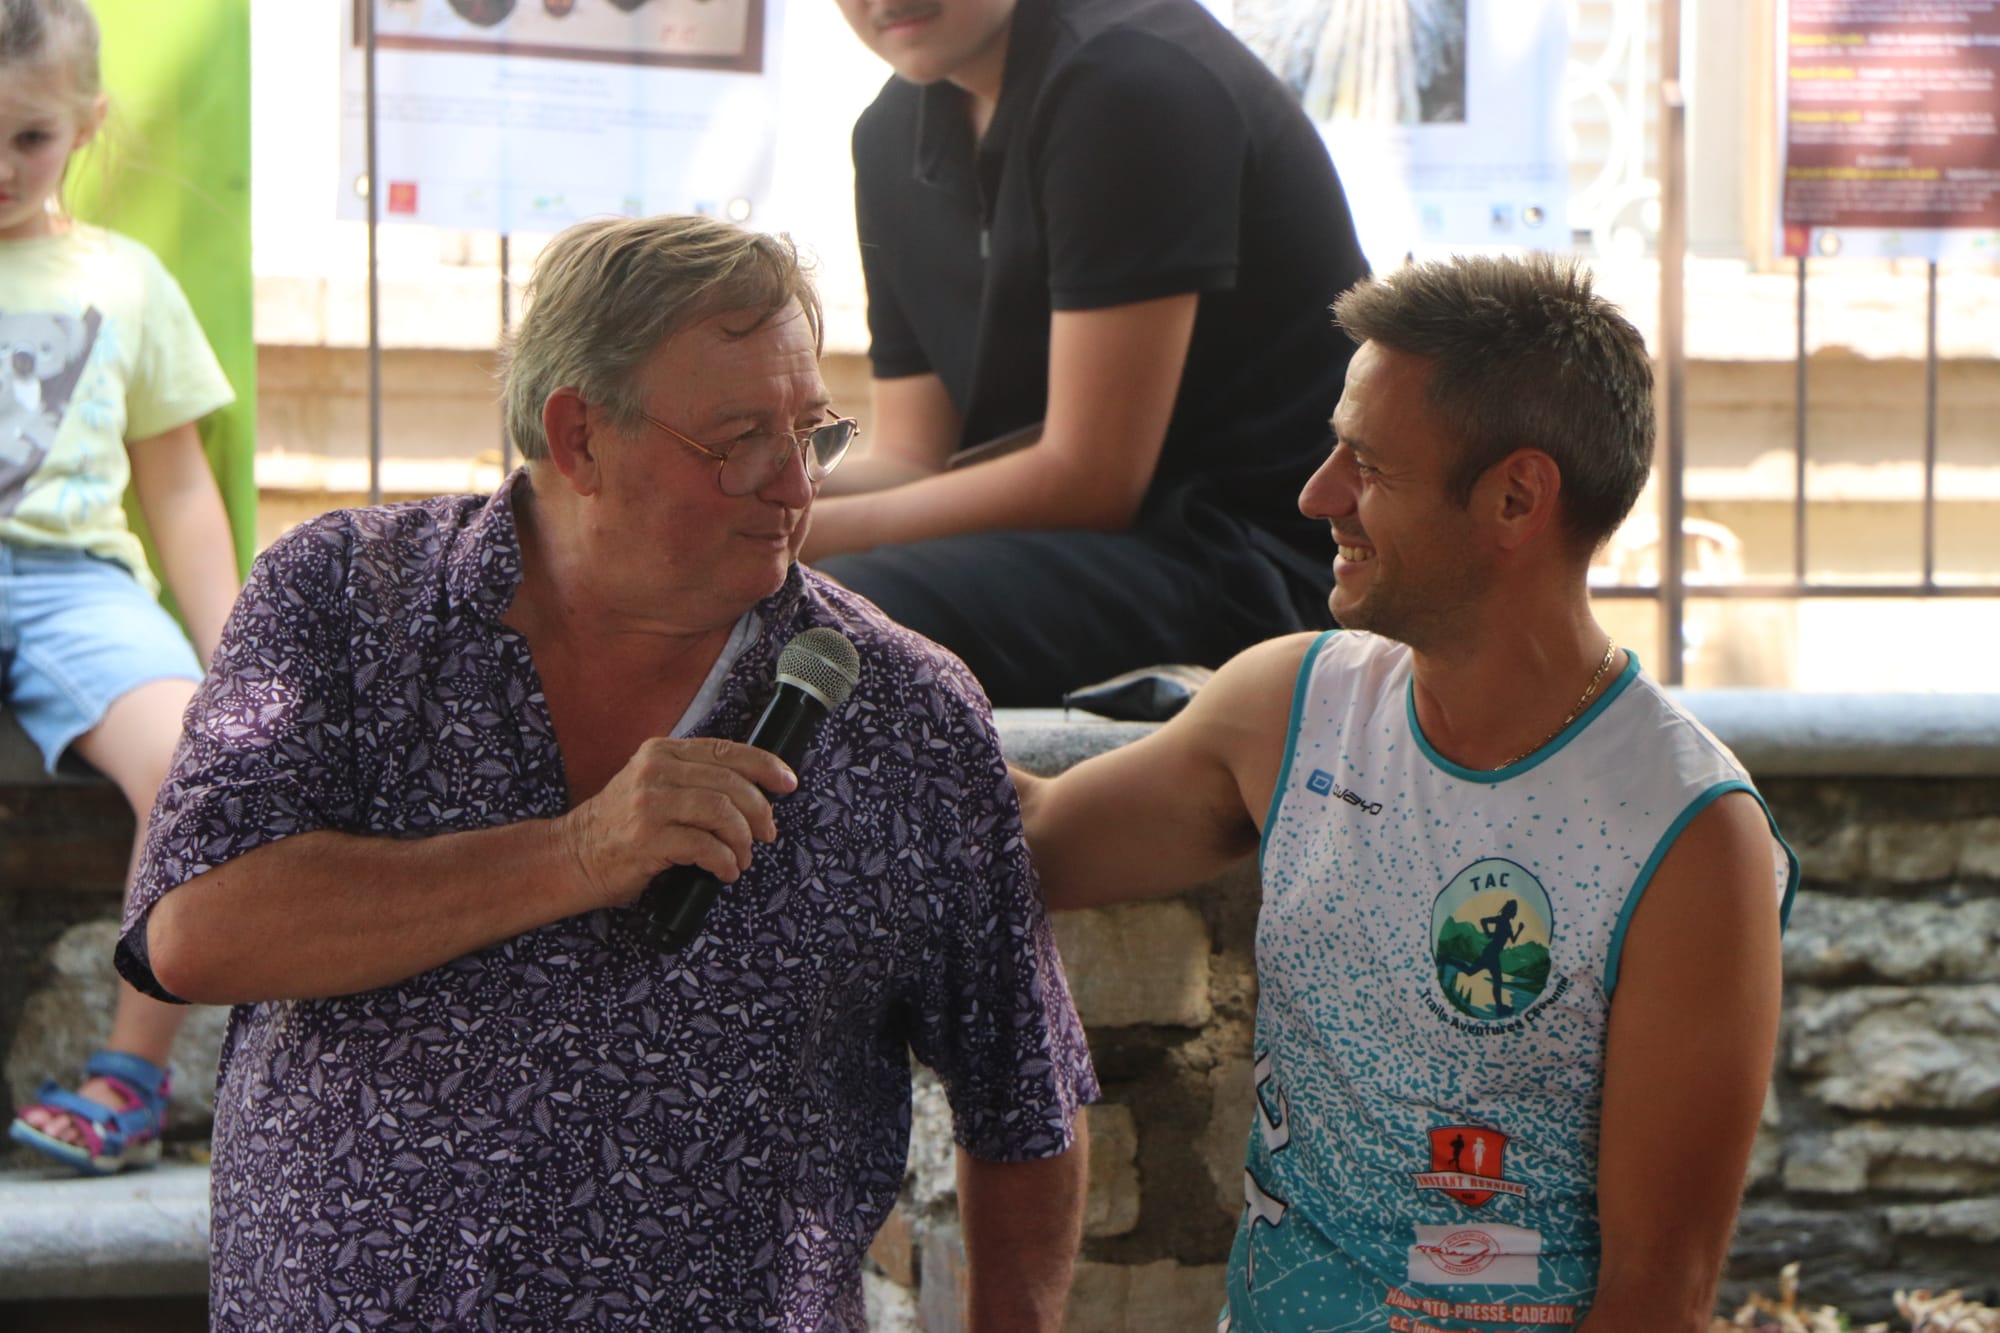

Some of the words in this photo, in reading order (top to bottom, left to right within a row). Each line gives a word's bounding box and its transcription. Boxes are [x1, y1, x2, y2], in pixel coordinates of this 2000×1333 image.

[1470, 873, 1510, 892] TAC
[1420, 987, 1449, 1023] Trails
[1449, 1016, 1525, 1036] Aventures
[1416, 1175, 1464, 1188] INSTANT
